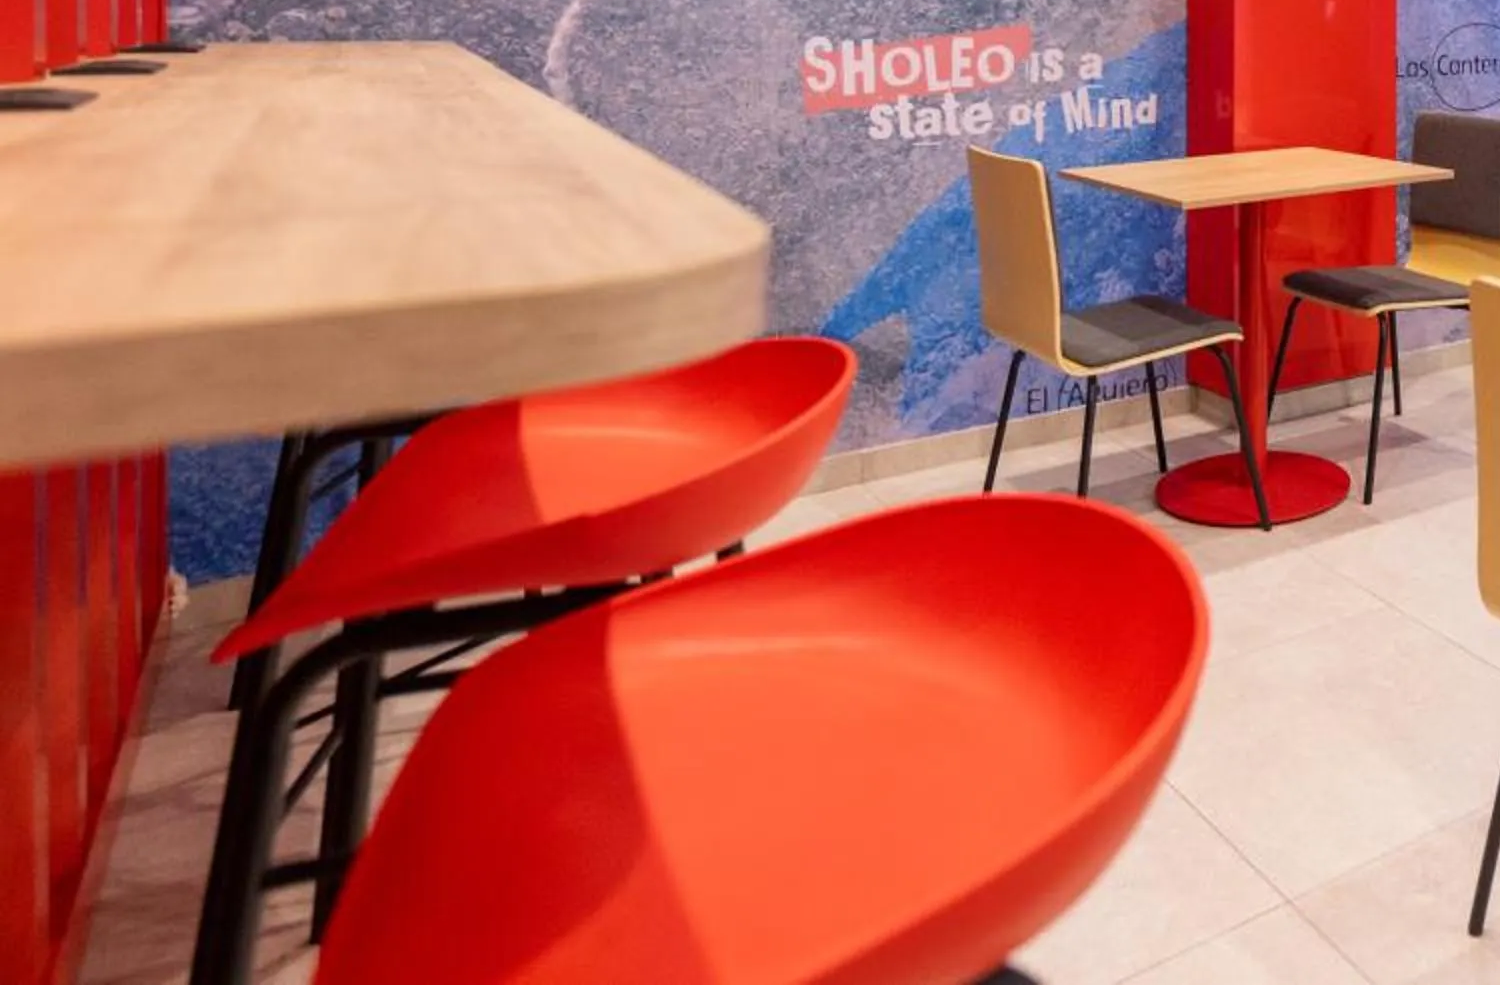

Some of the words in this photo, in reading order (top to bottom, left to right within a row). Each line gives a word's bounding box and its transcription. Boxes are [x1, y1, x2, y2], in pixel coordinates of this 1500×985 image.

[803, 36, 1014, 95] SHOLEO
[1080, 52, 1103, 79] a
[868, 92, 993, 140] state
[1009, 100, 1046, 143] of
[1061, 87, 1157, 134] Mind
[1026, 385, 1048, 415] El
